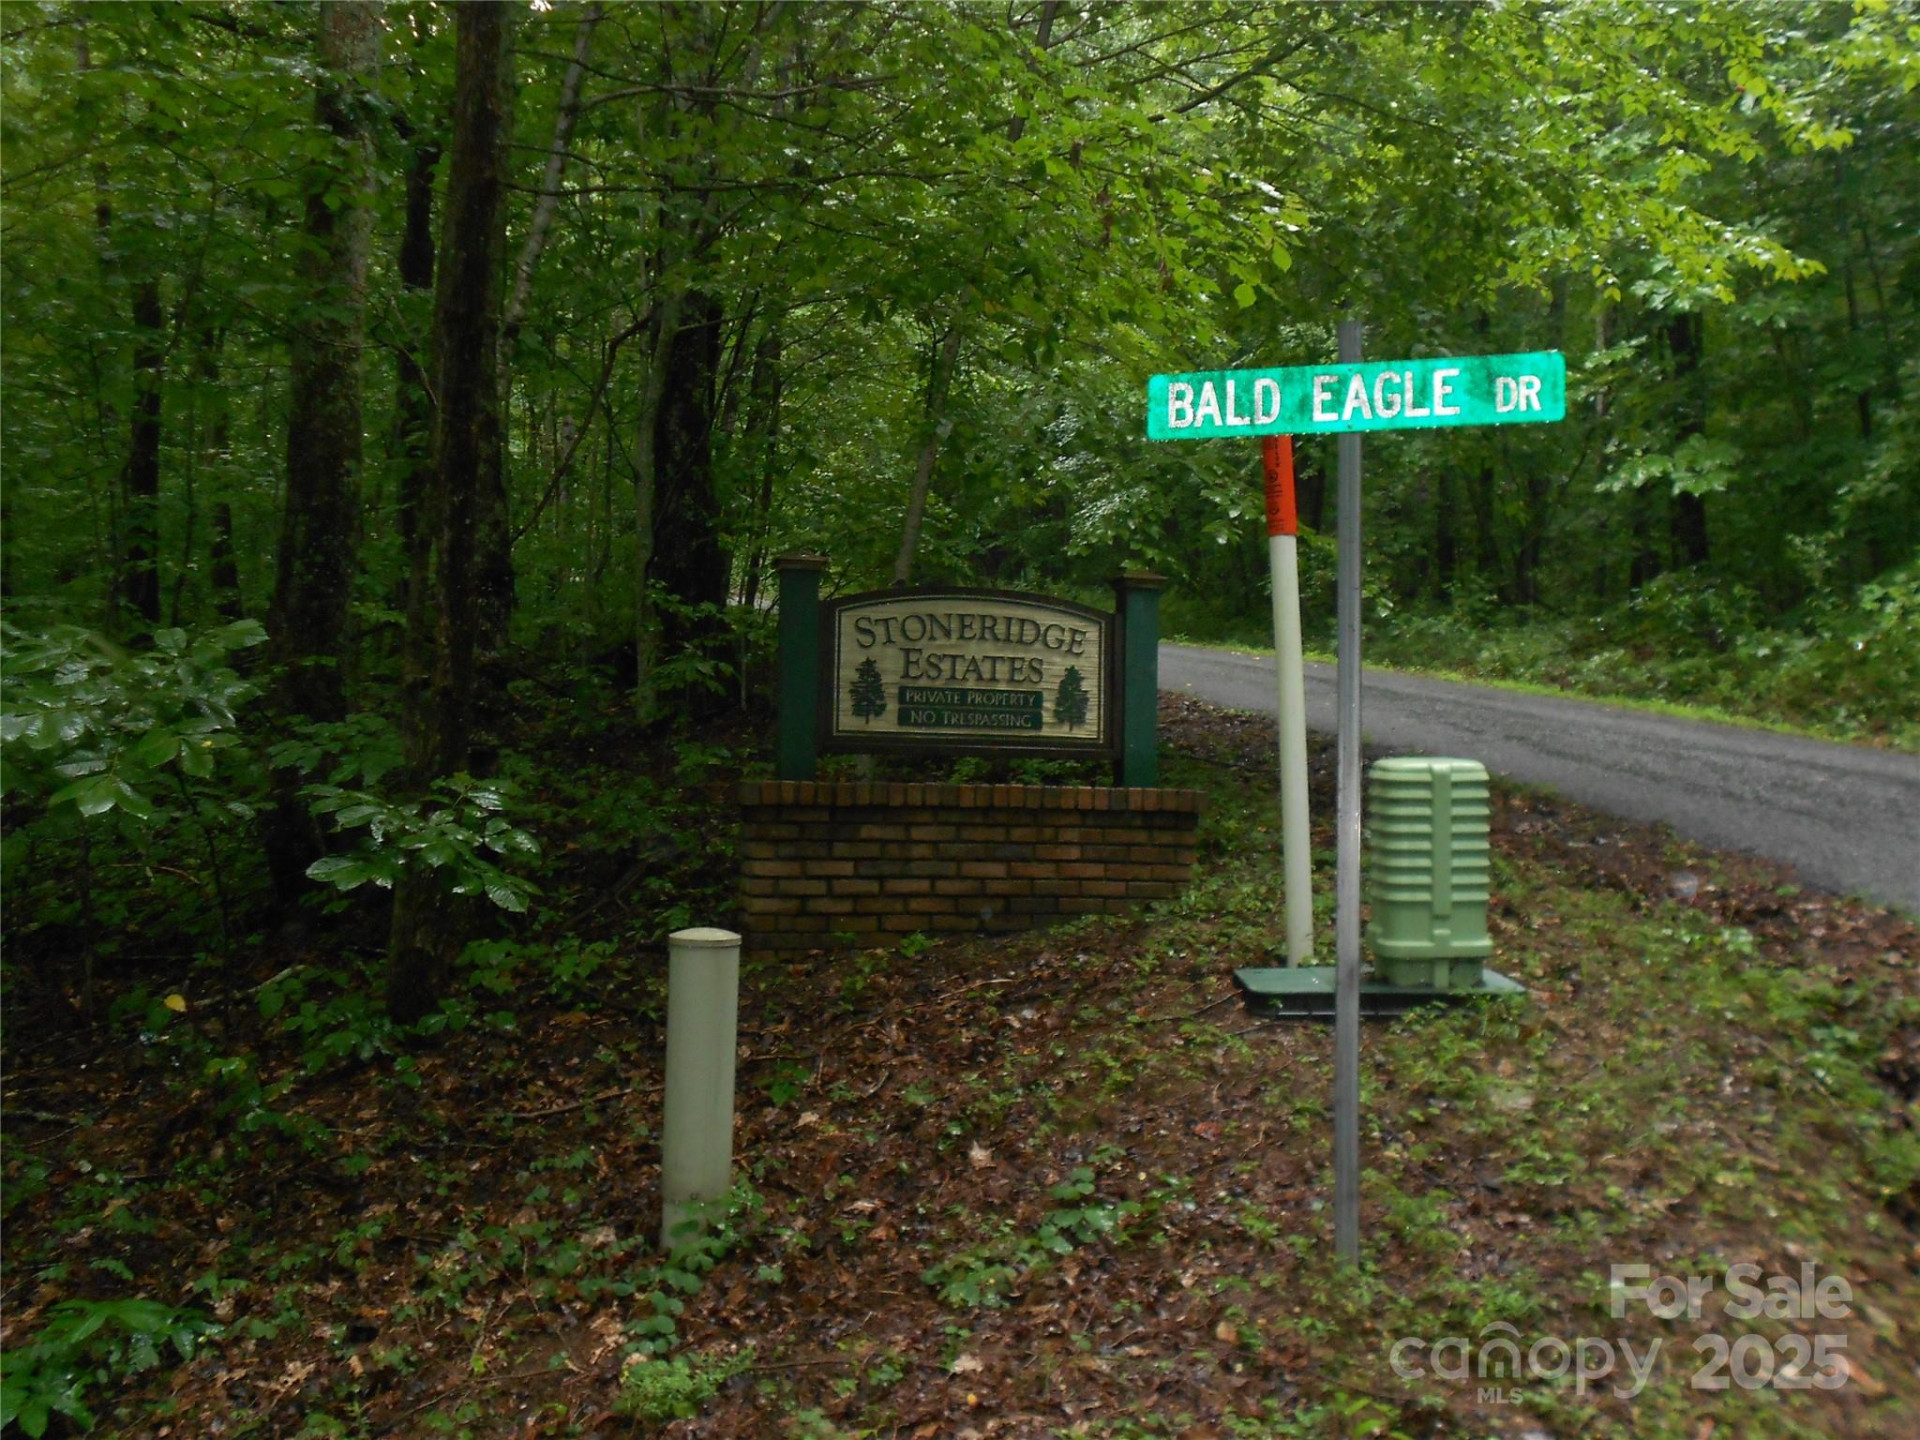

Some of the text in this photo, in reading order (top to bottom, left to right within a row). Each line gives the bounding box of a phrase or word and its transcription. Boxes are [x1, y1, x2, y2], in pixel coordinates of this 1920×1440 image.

[1168, 368, 1542, 429] BALD EAGLE DR
[855, 613, 1087, 655] STONERIDGE
[900, 648, 1044, 684] ESTATES
[905, 690, 961, 704] PRIVATE
[910, 710, 936, 724] NO
